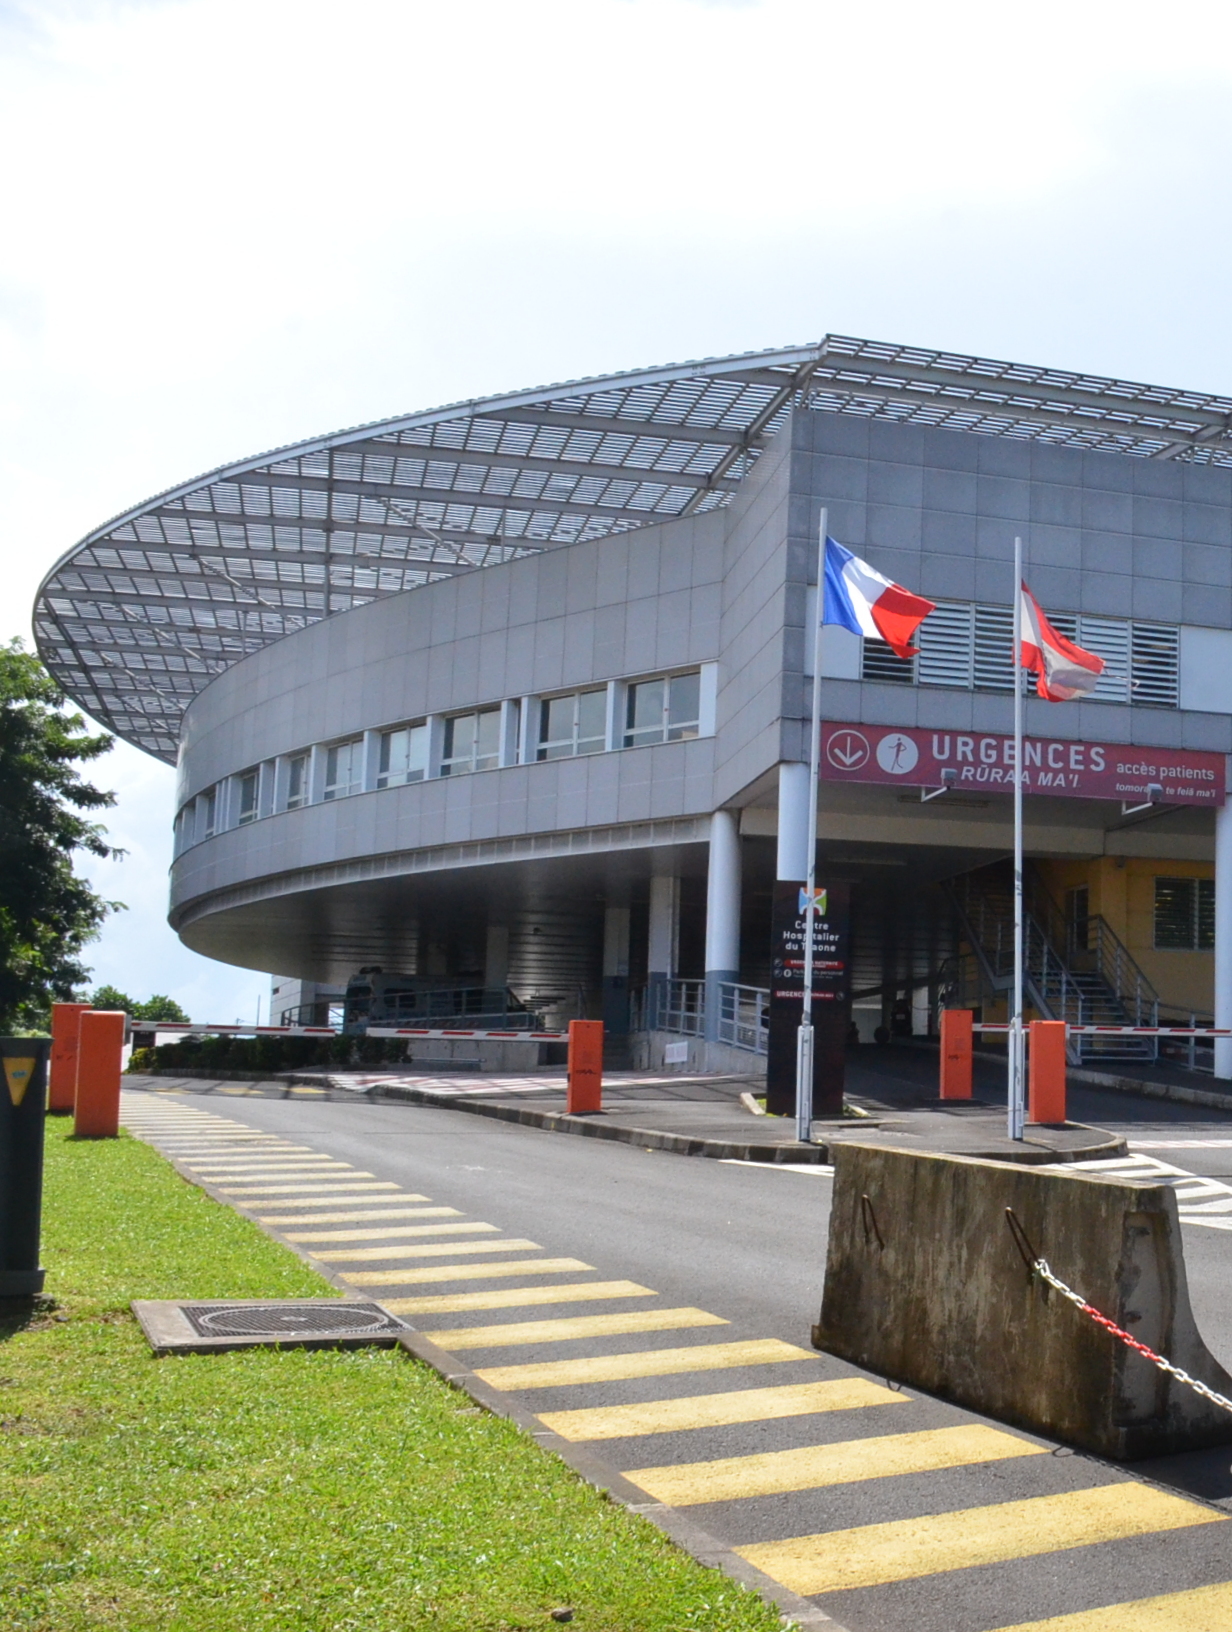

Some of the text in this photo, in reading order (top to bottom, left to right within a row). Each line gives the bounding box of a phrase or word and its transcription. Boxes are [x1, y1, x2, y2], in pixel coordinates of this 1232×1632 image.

[932, 734, 1106, 772] URGENCES
[1116, 761, 1215, 781] accès patients
[795, 920, 829, 930] Cetre
[783, 930, 840, 942] Hosptalier
[785, 941, 836, 952] du Taone
[776, 990, 808, 998] URGENC
